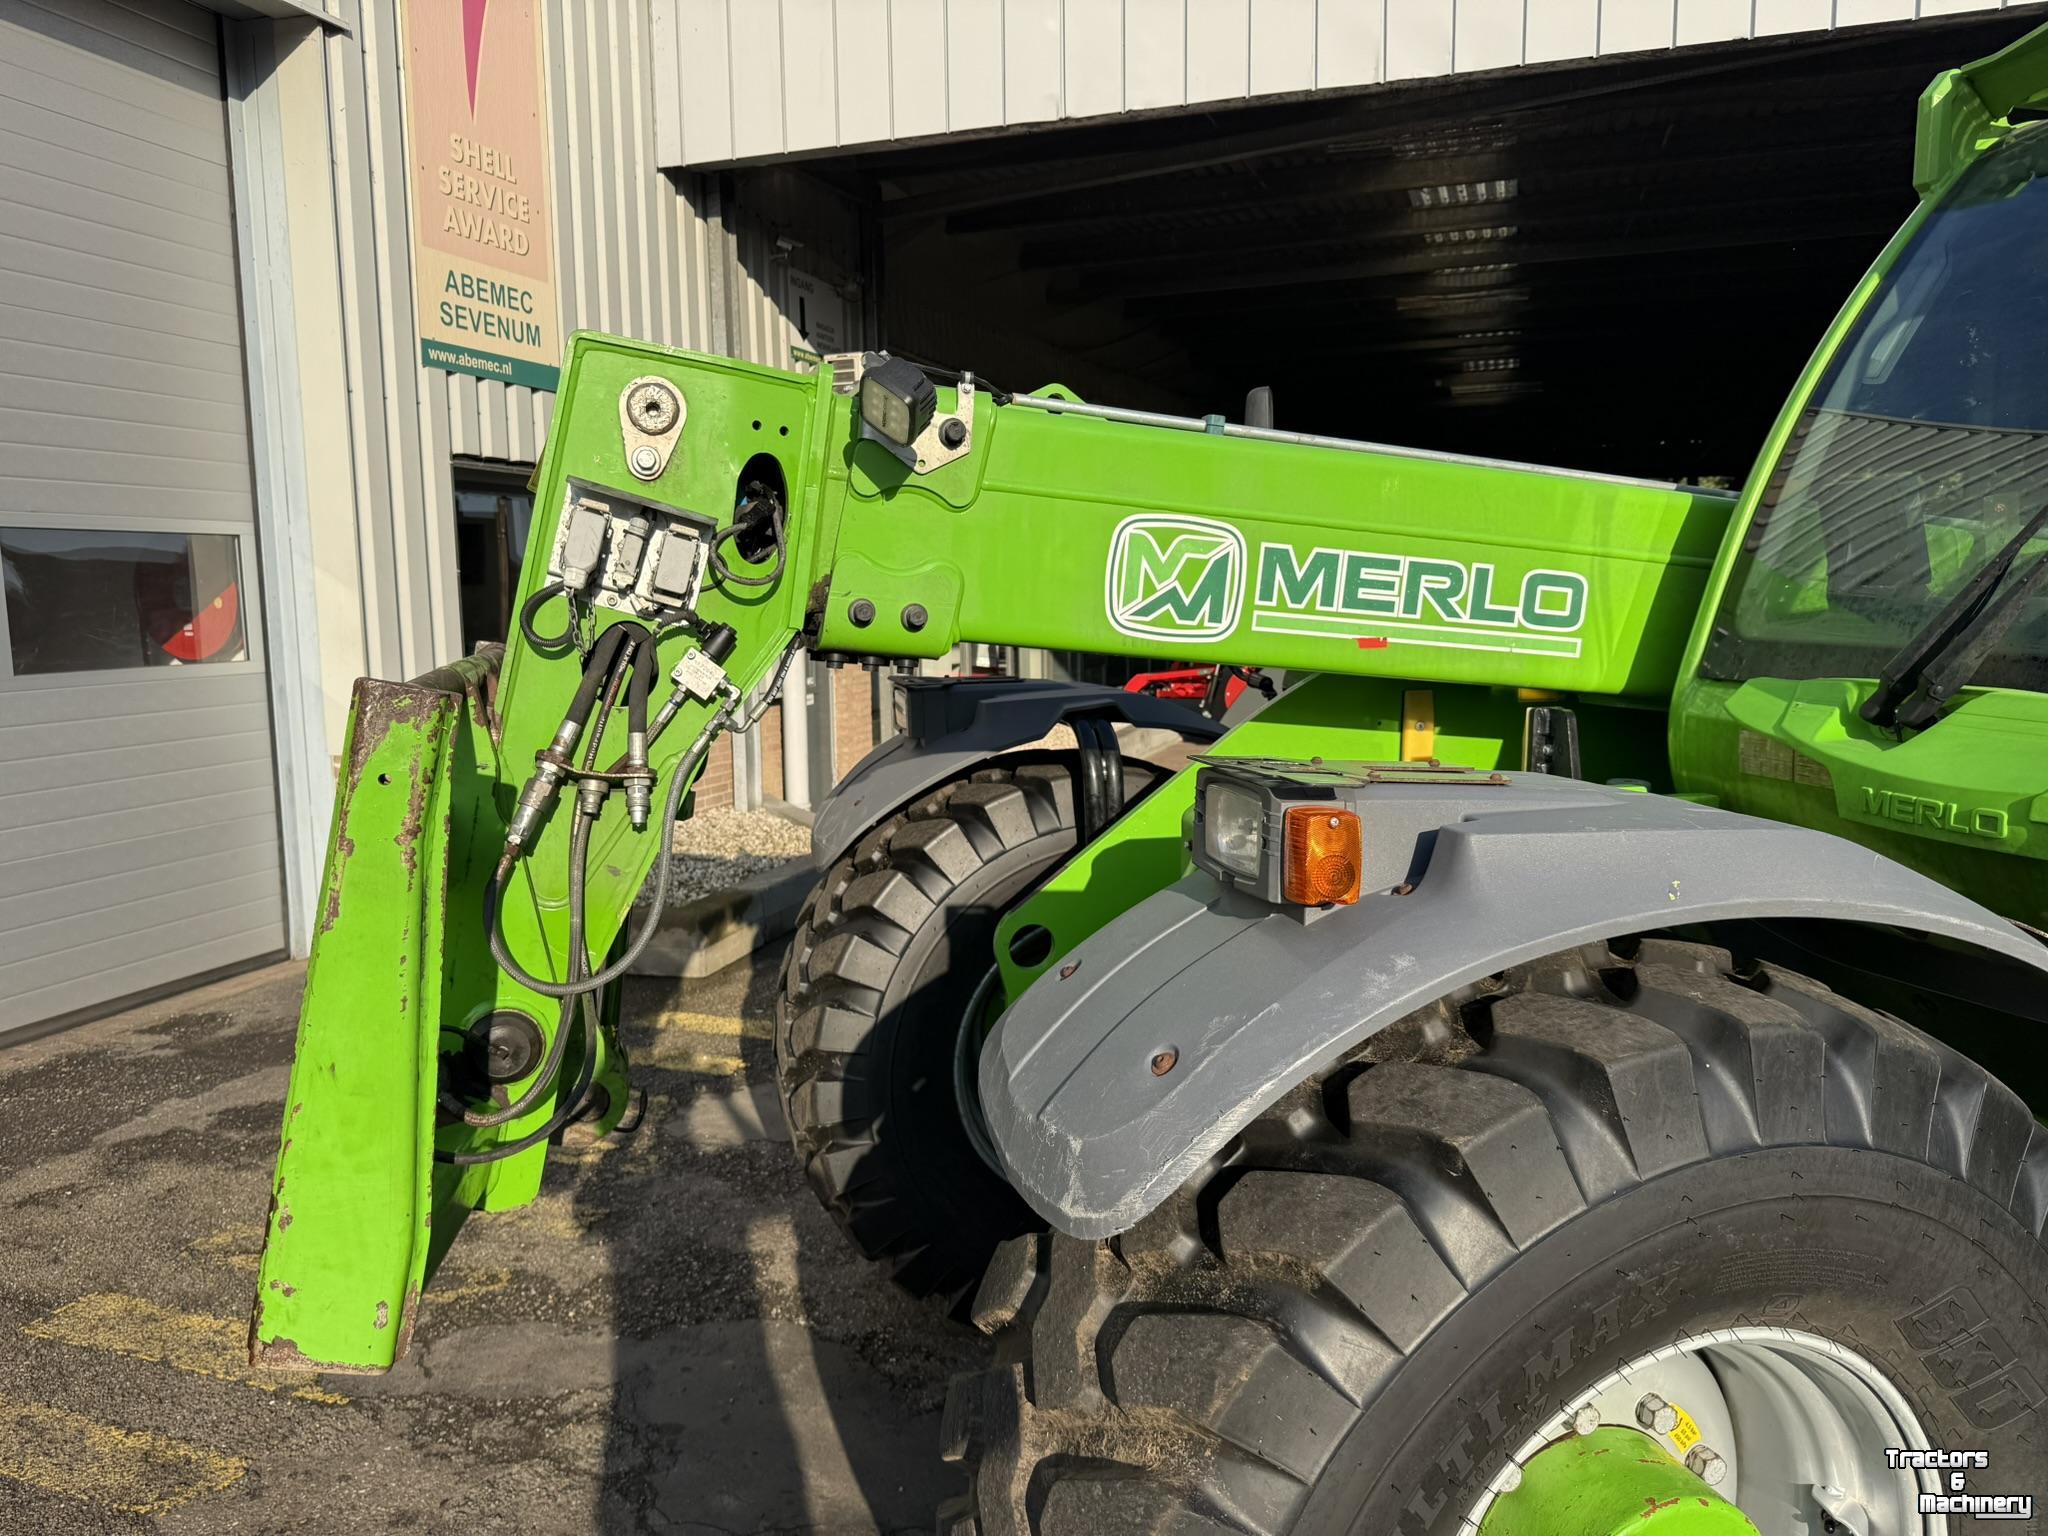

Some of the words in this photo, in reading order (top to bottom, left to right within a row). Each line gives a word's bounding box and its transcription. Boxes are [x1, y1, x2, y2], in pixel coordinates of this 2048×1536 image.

[450, 133, 518, 185] SHELL
[438, 165, 531, 224] SERVICE
[443, 206, 530, 257] AWARD
[445, 270, 533, 315] ABEMEC
[440, 301, 541, 348] SEVENUM
[428, 348, 512, 376] www.abemec.nl
[1255, 541, 1588, 633] MERLO
[1860, 786, 2009, 839] MERLO
[1389, 1263, 1681, 1536] LTIMAX
